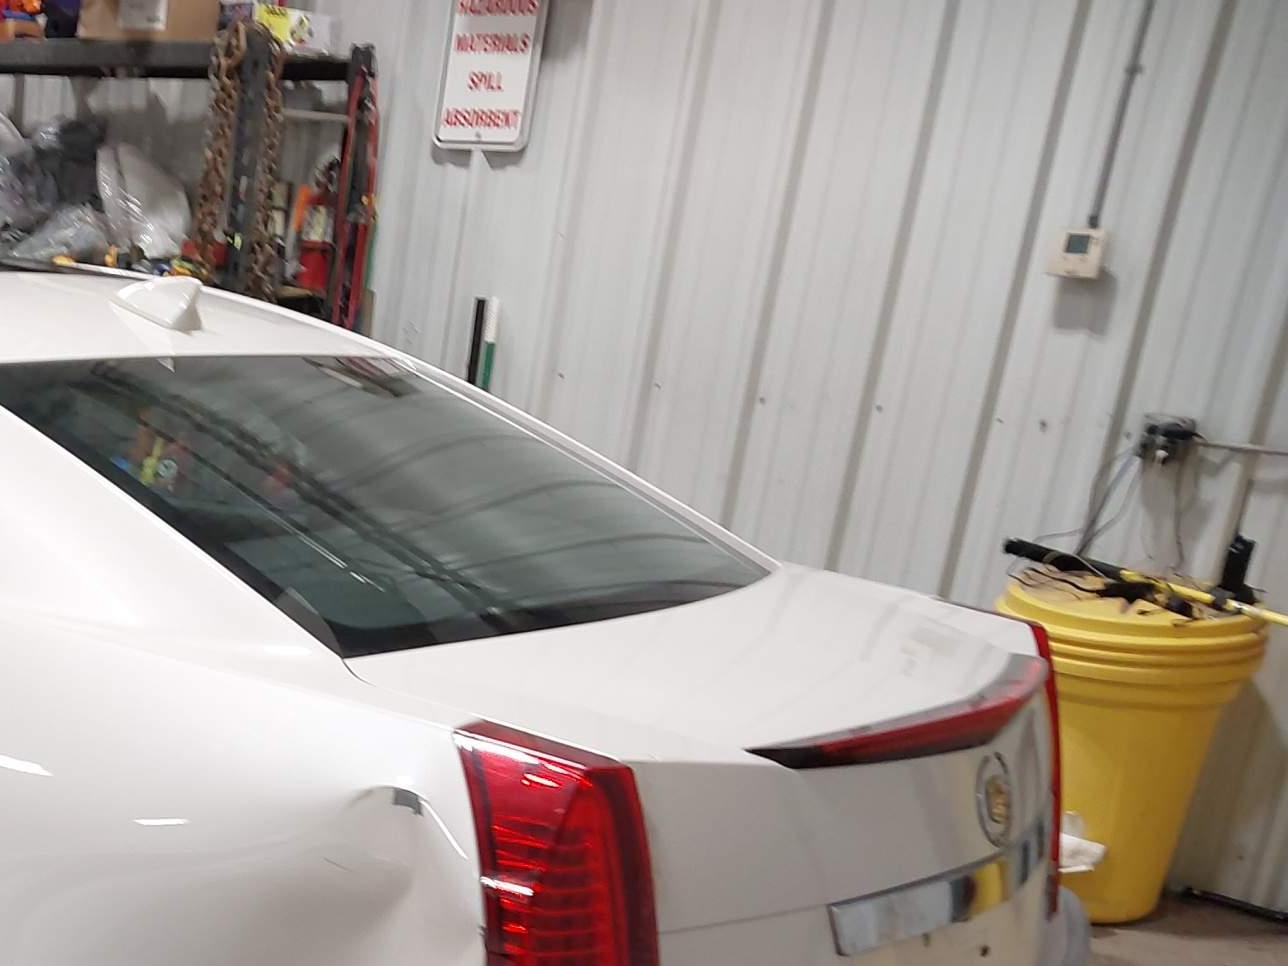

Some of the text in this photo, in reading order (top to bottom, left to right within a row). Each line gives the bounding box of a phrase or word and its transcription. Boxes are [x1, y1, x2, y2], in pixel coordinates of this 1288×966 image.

[454, 32, 531, 52] MATERIALS
[467, 71, 504, 91] SPILL
[442, 107, 521, 128] ABSORBENT
